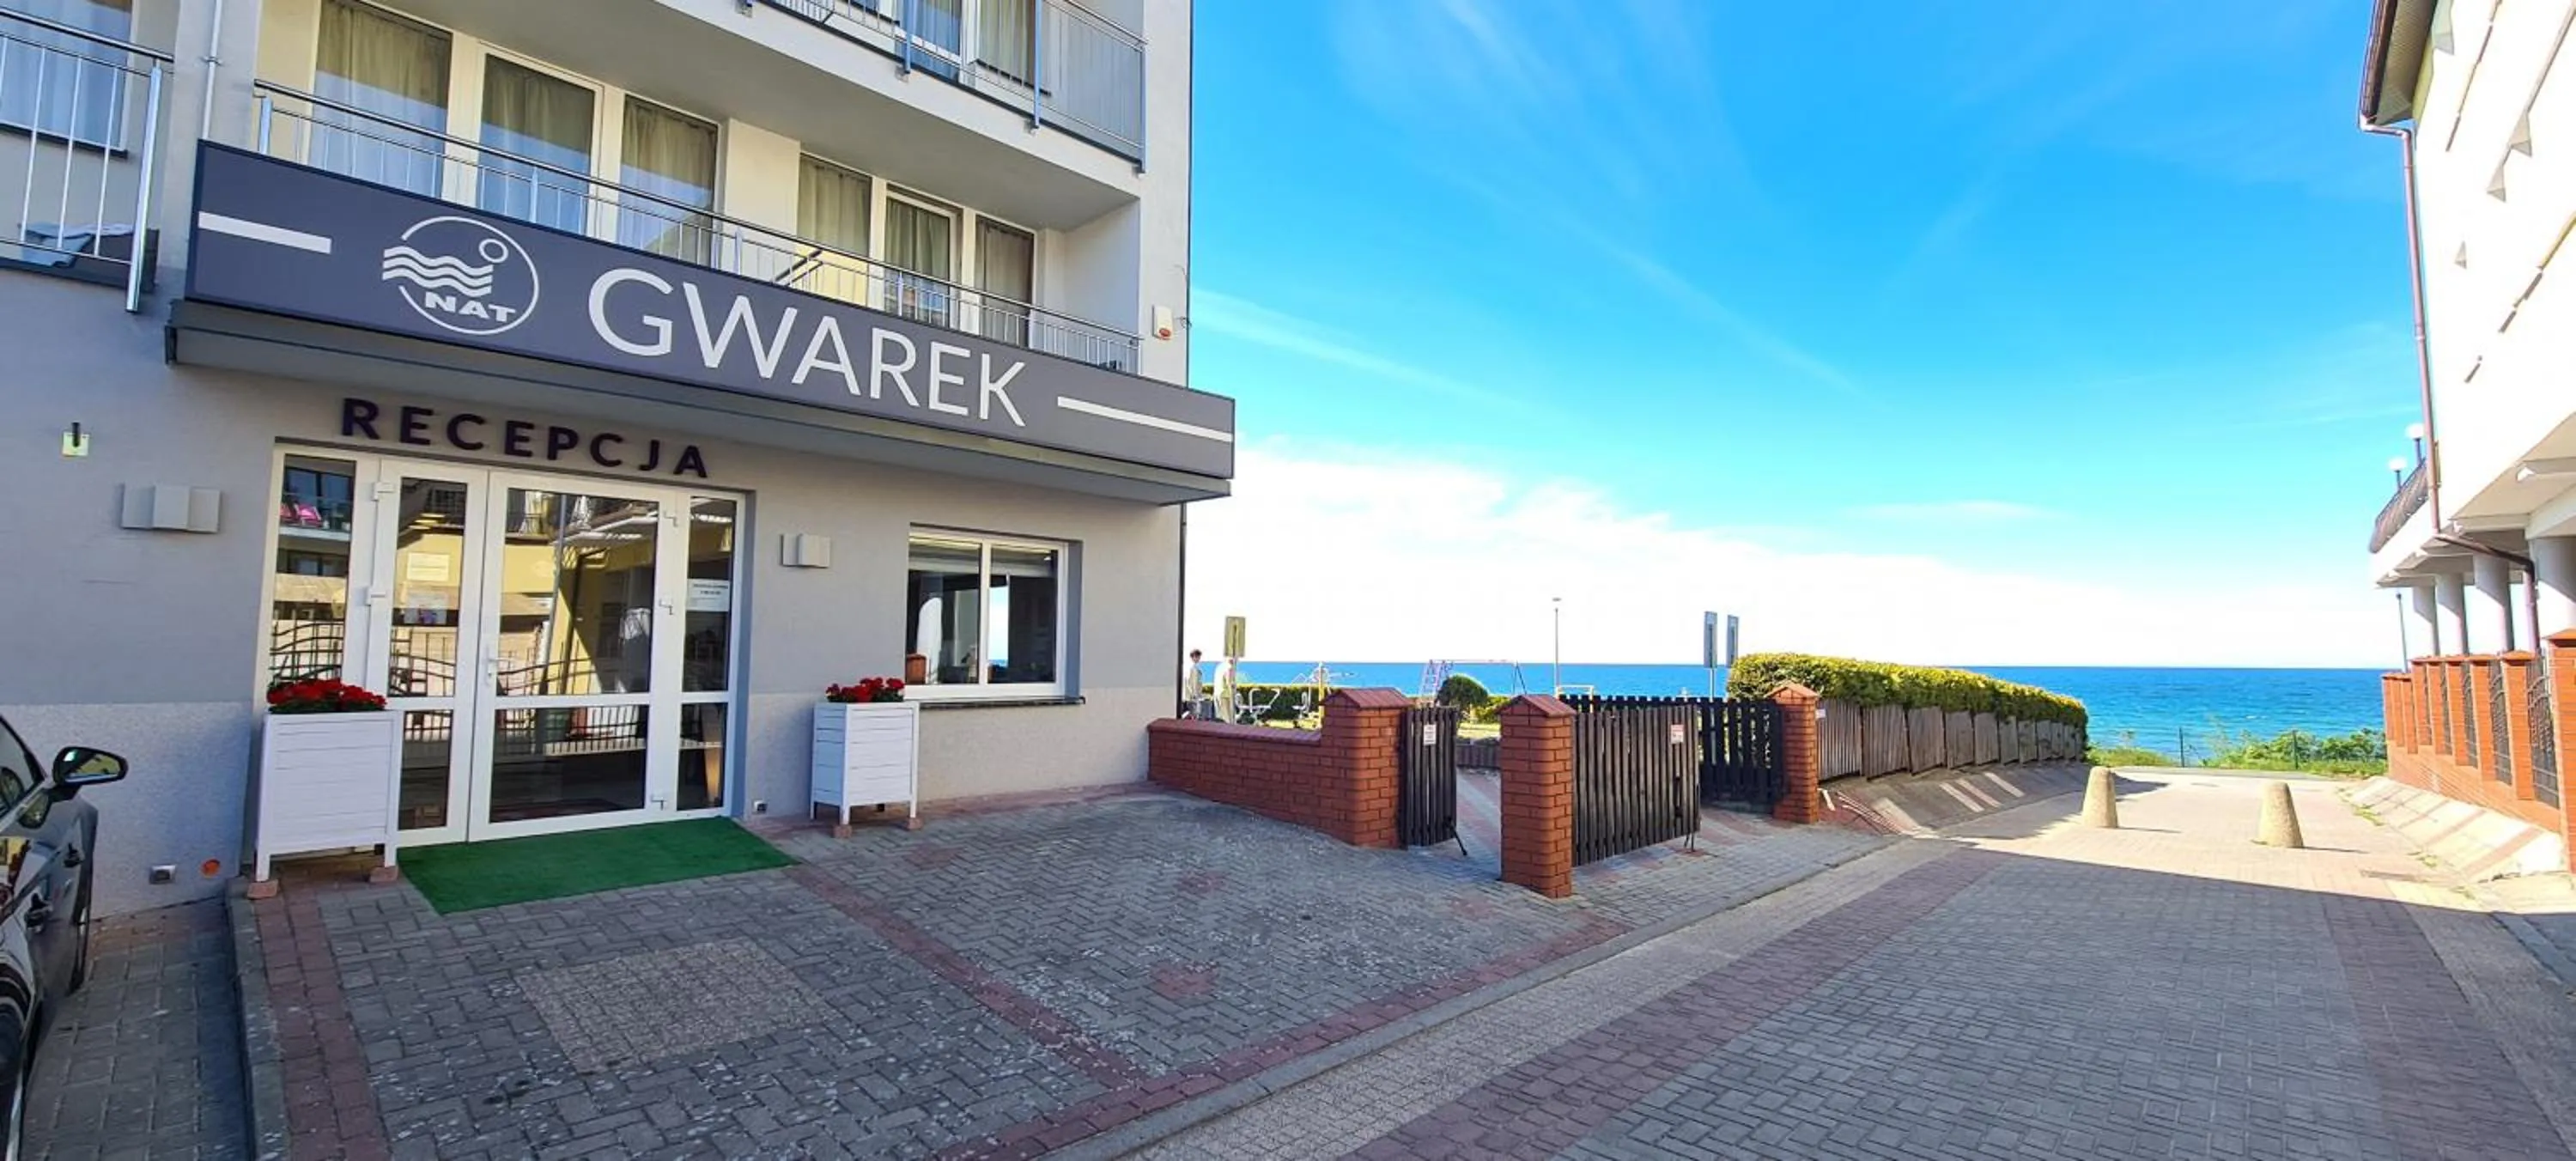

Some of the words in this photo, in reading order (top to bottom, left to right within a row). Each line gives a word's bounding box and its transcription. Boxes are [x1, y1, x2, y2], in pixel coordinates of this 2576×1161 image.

[425, 292, 516, 322] NAT
[587, 268, 1026, 428] GWAREK
[342, 398, 708, 478] RECEPCJA
